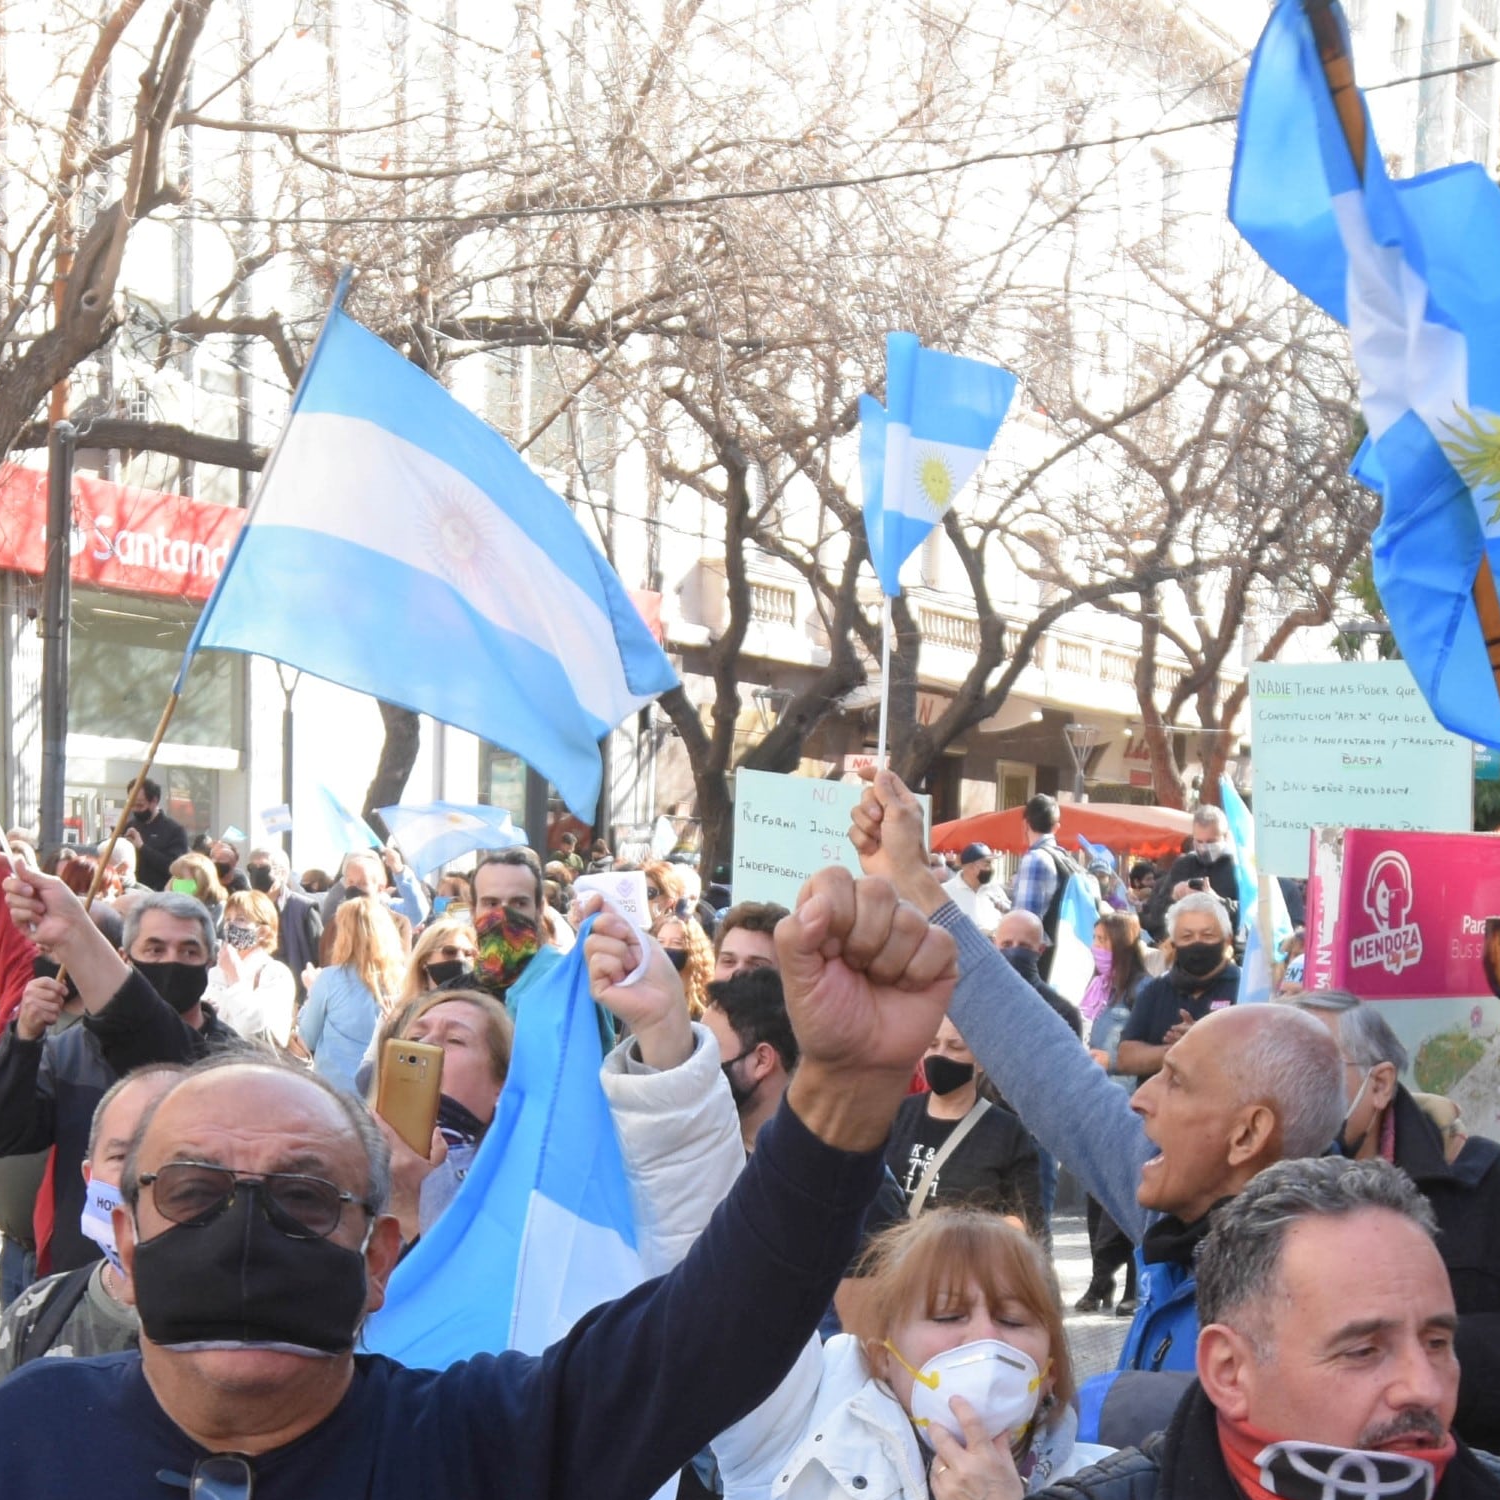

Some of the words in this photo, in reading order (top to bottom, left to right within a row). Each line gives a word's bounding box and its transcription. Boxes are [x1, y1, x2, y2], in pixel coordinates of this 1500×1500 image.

[93, 514, 232, 578] Santand
[1256, 679, 1292, 695] NADIE
[1341, 752, 1383, 765] BASTA
[812, 786, 839, 805] NO
[821, 845, 841, 861] SI
[1463, 914, 1487, 935] Para
[1353, 927, 1421, 964] MENDOZA
